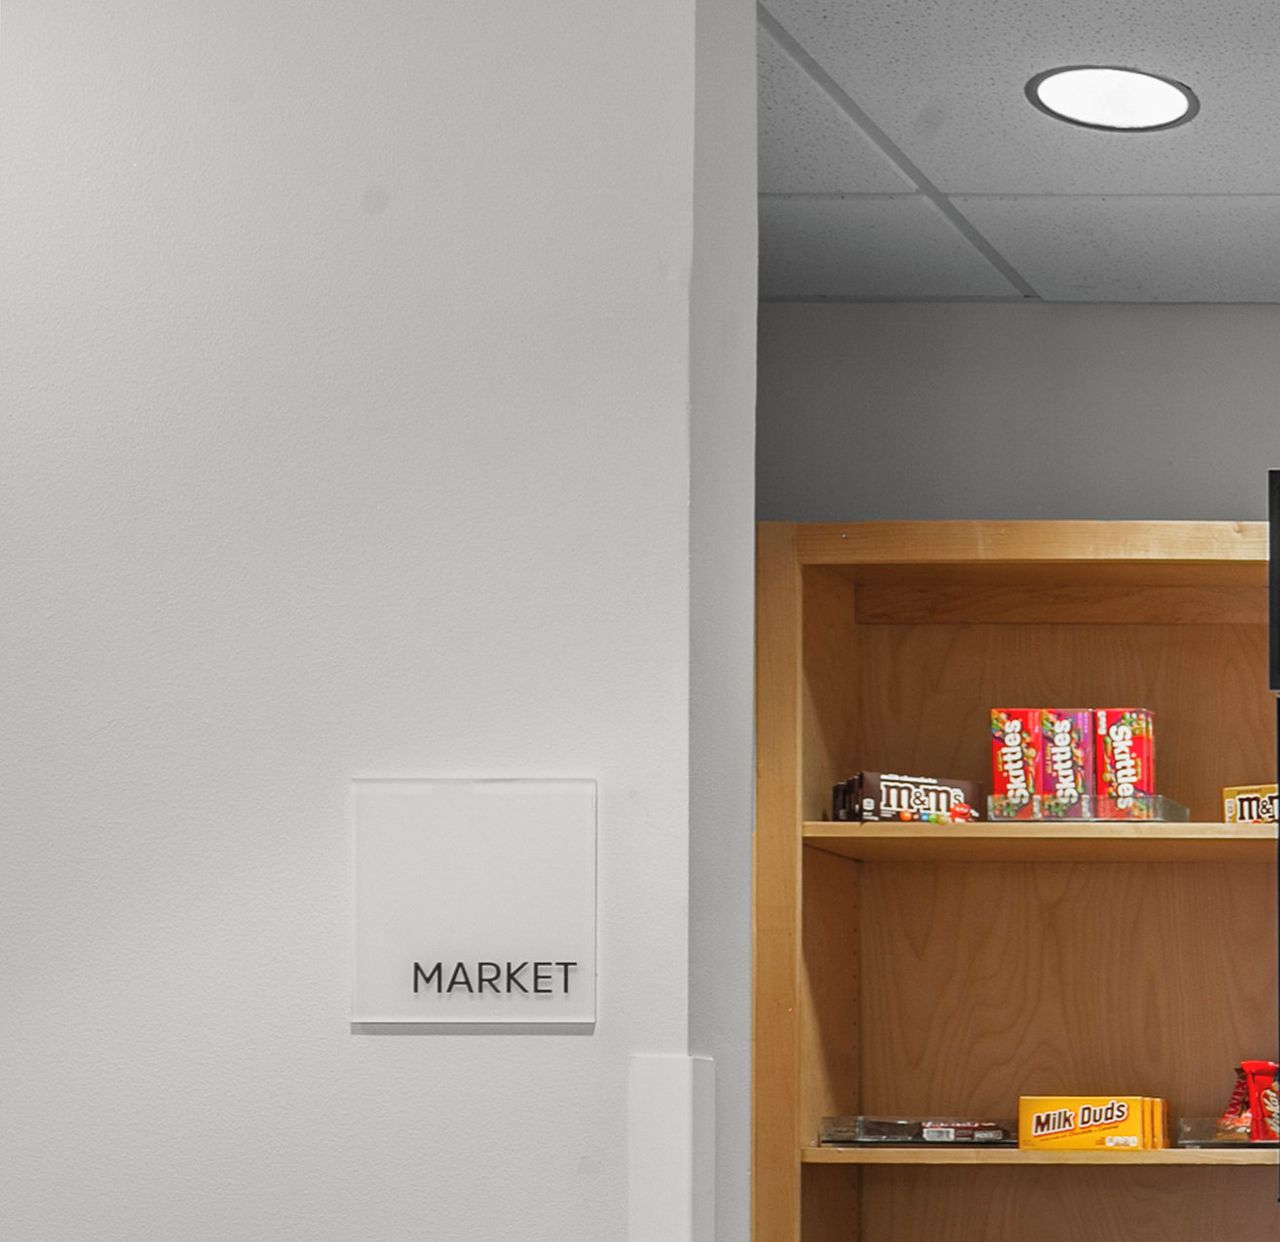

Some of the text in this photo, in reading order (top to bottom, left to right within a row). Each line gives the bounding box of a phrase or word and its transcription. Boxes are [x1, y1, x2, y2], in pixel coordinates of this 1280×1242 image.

[1001, 718, 1030, 806] Skittles
[1052, 718, 1079, 806] Skittles
[1109, 724, 1135, 811] Skittles
[413, 962, 577, 993] MARKET
[1033, 1109, 1075, 1136] Milk
[1079, 1101, 1128, 1129] Duds
